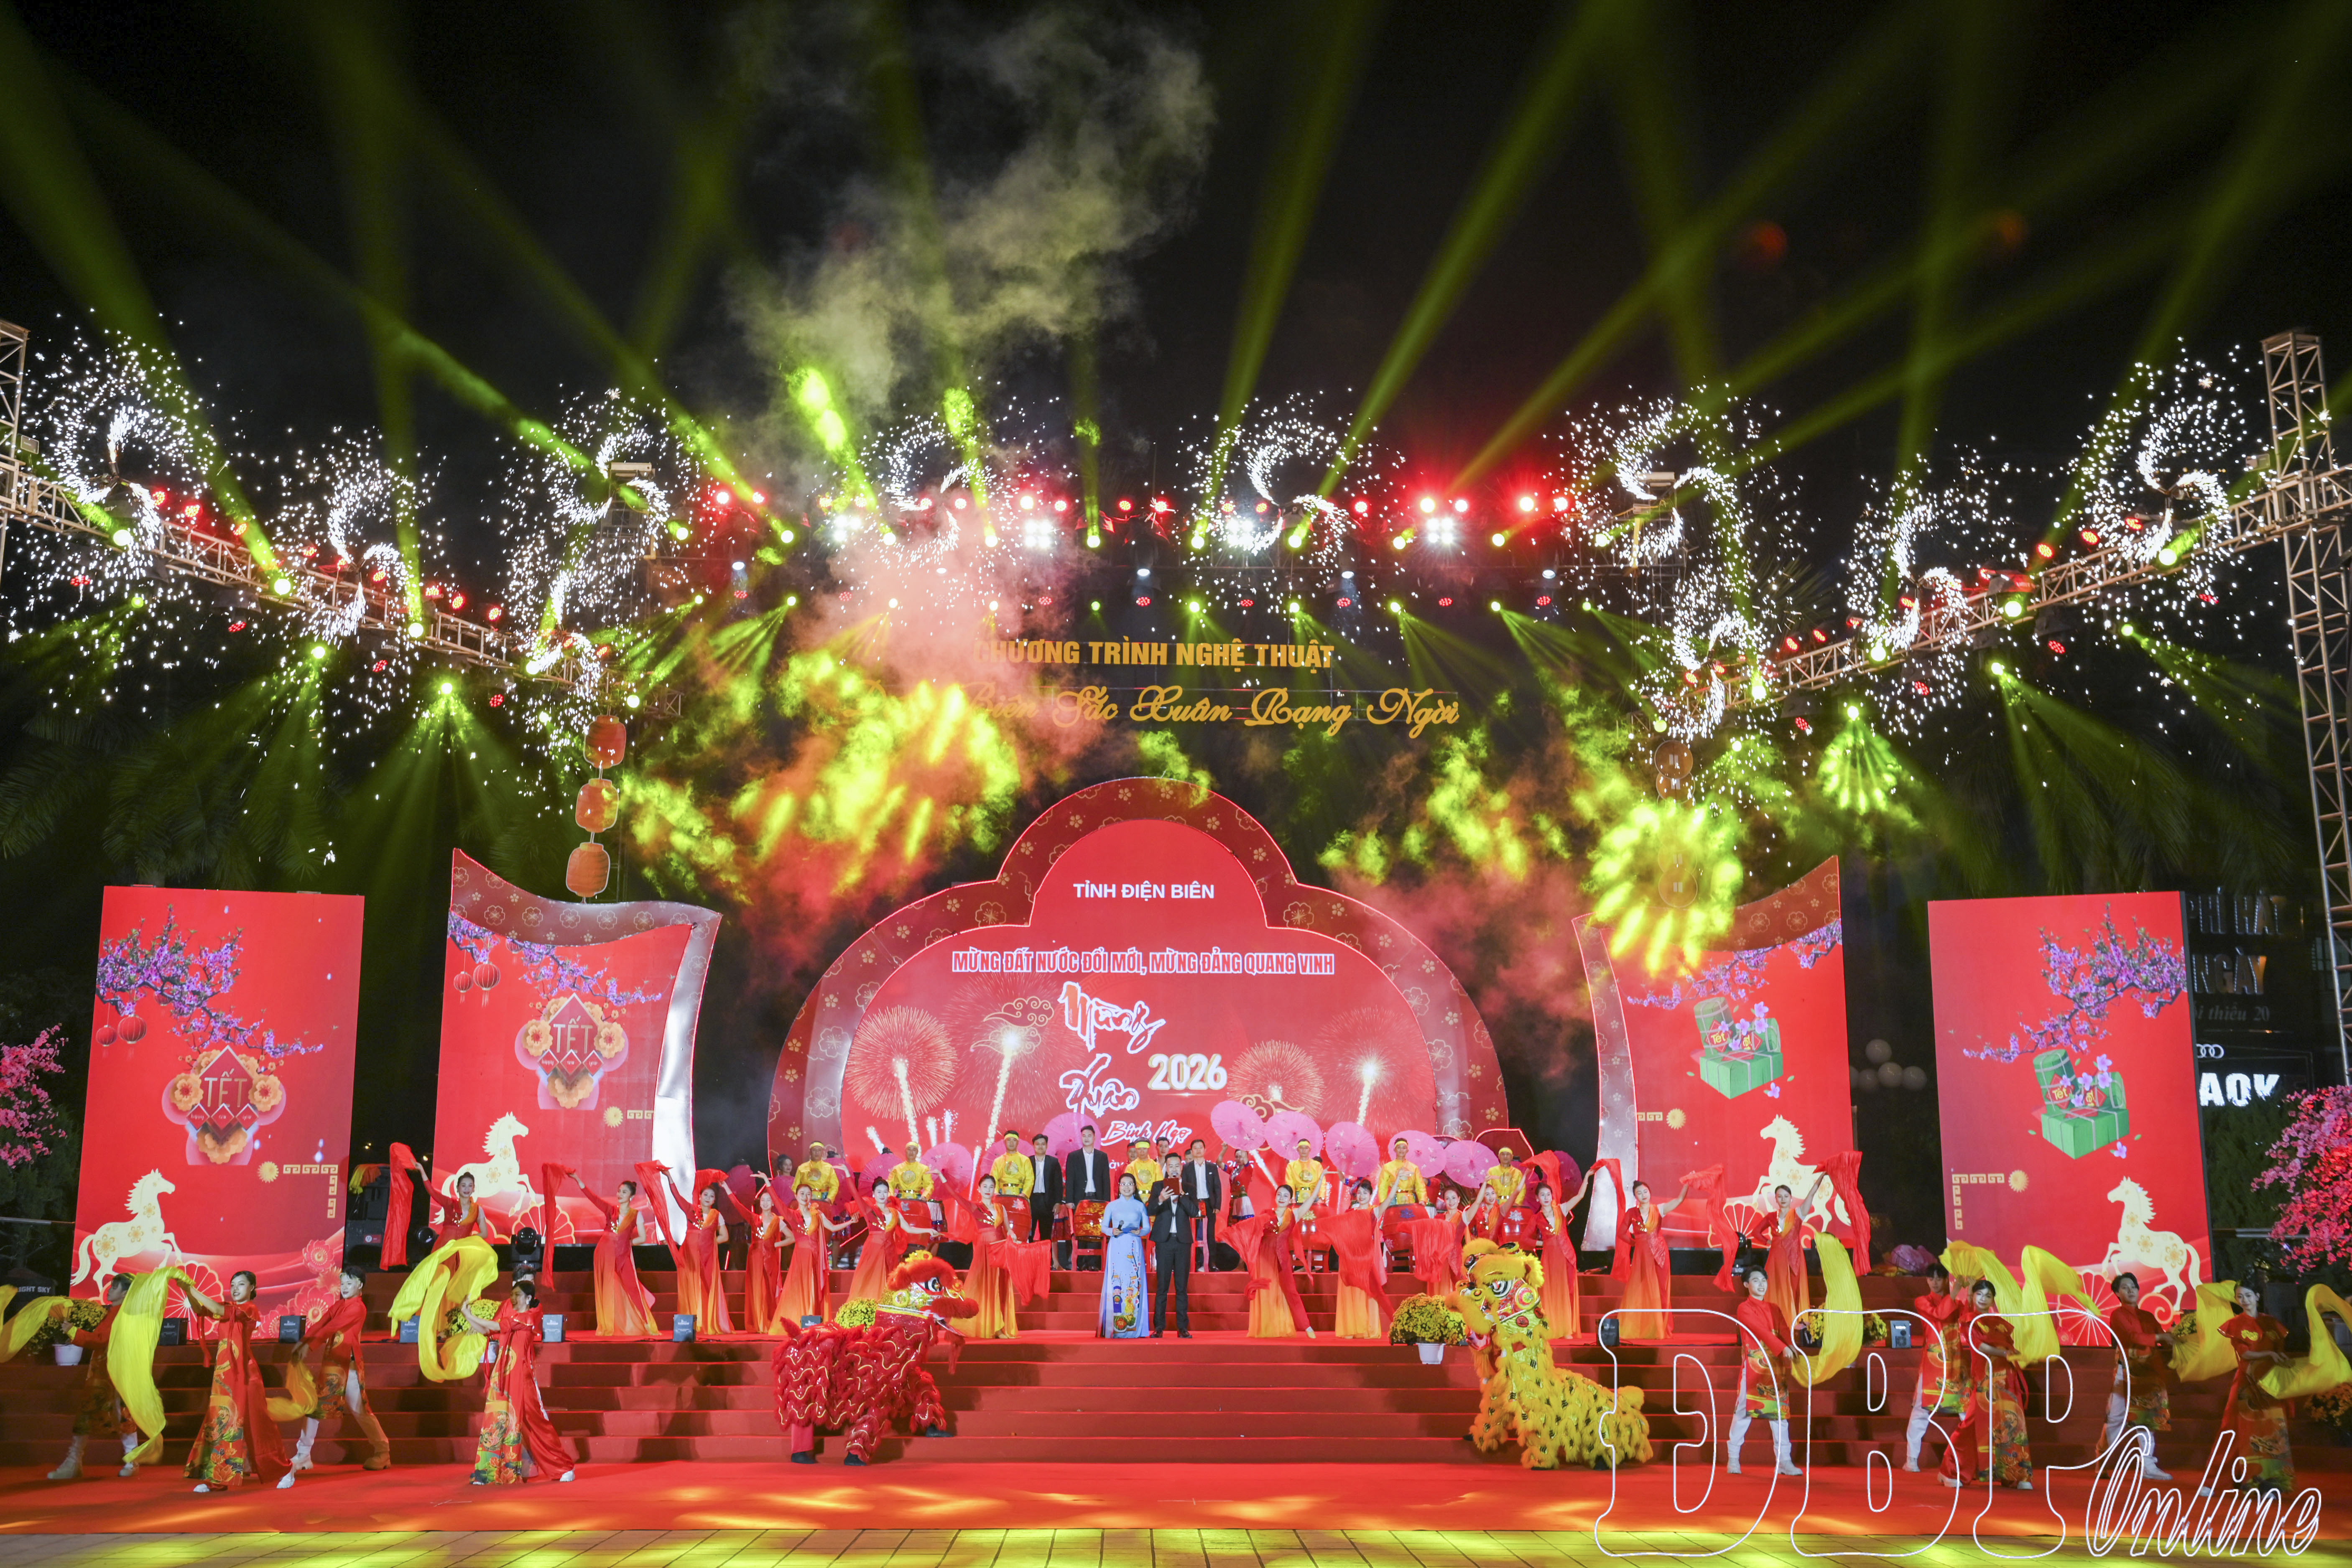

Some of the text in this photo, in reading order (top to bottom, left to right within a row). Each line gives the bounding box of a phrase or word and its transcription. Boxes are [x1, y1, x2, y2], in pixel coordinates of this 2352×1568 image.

[974, 635, 1334, 674] CHƯƠNG TRÌNH NGHỆ THUẬT
[1052, 686, 1118, 728] Sắc
[1130, 685, 1232, 722] Xuân
[1244, 687, 1352, 737] Rạng
[1367, 688, 1460, 739] Ngời
[1073, 882, 1215, 902] TỈNH ĐIỆN BIÊN
[952, 946, 1334, 975] MỪNG ĐẤT NƯỚC ĐỔI MỚI, MỪNG ĐẢNG QUANG VINH
[553, 1015, 593, 1054] TẾT
[204, 1068, 247, 1107] TẾT
[1148, 1053, 1228, 1091] 2026
